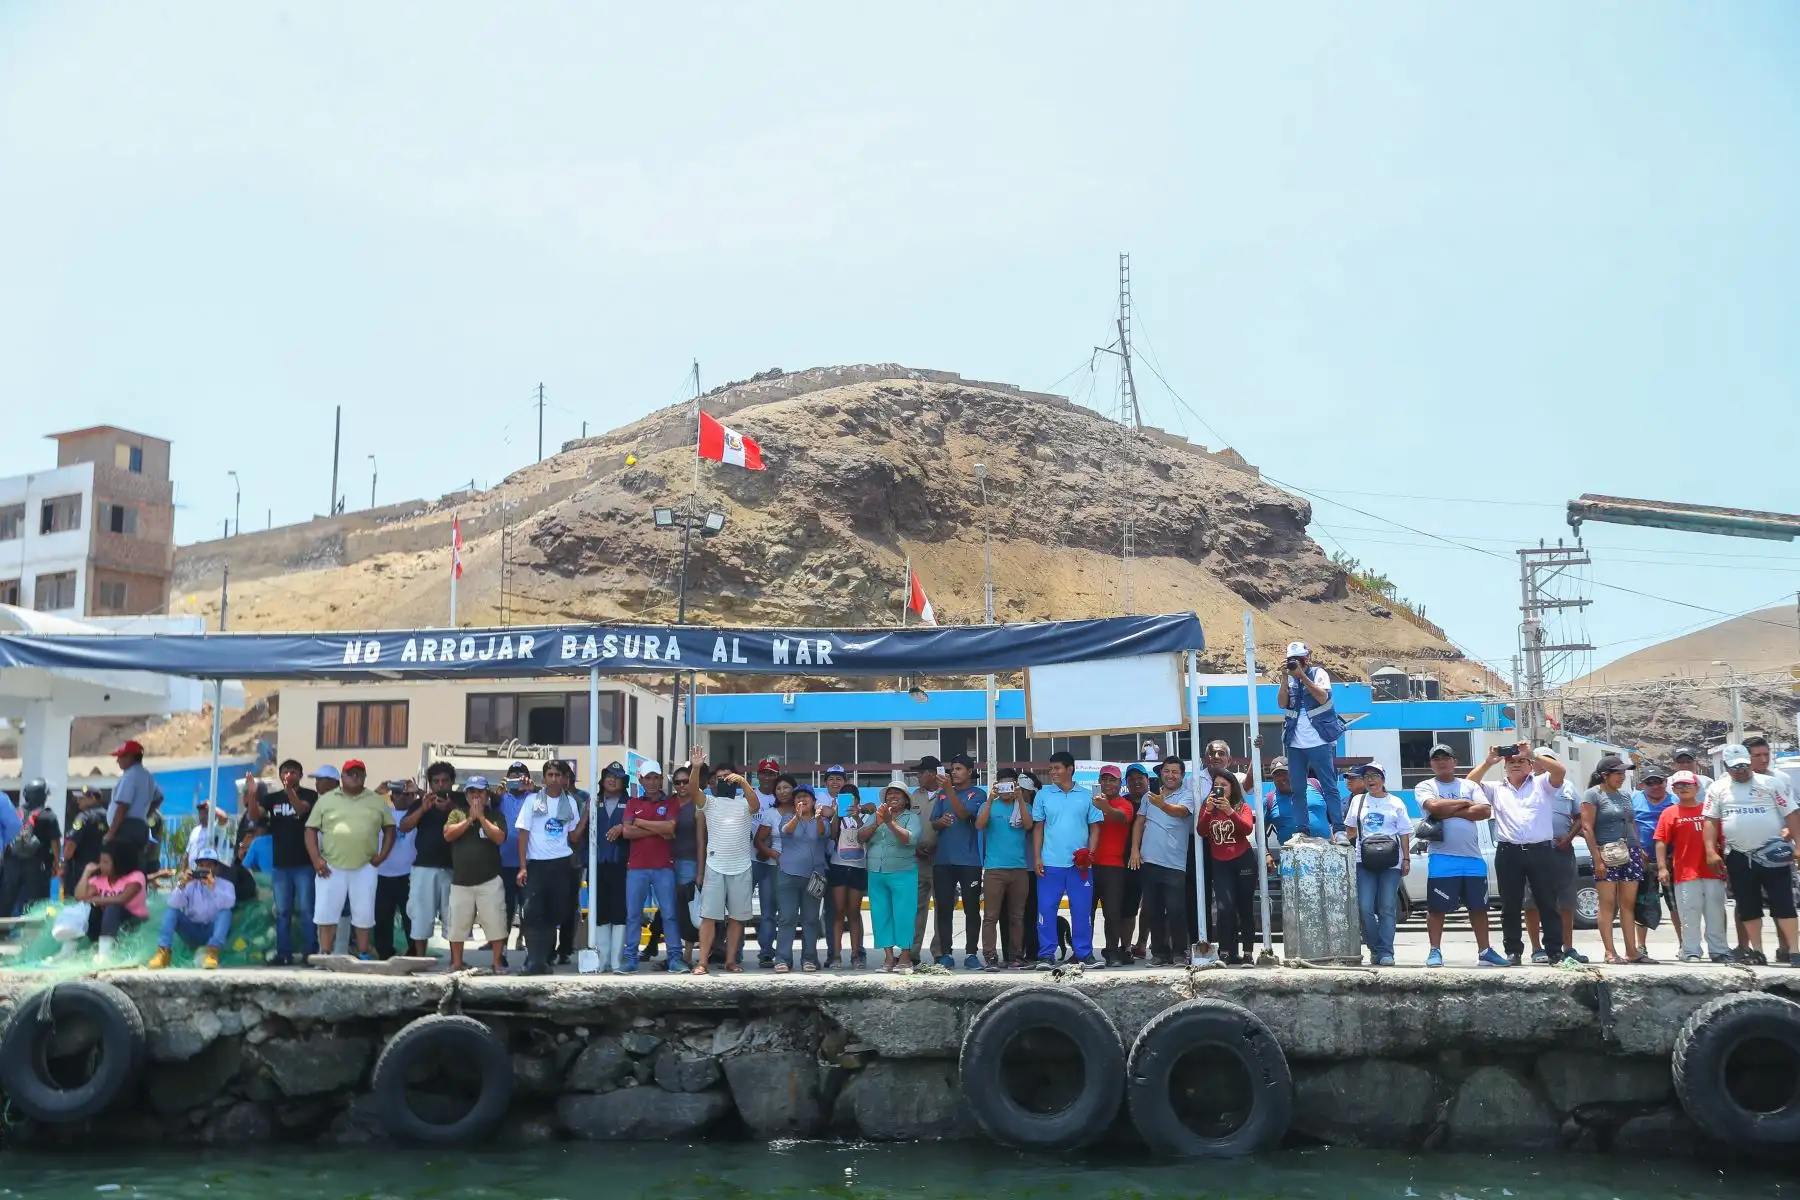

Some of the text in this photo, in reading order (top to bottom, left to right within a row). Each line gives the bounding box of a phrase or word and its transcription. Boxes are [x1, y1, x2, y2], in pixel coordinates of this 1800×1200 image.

[343, 634, 833, 665] NO ARROJAR BASURA AL MAR
[273, 802, 296, 816] FILA
